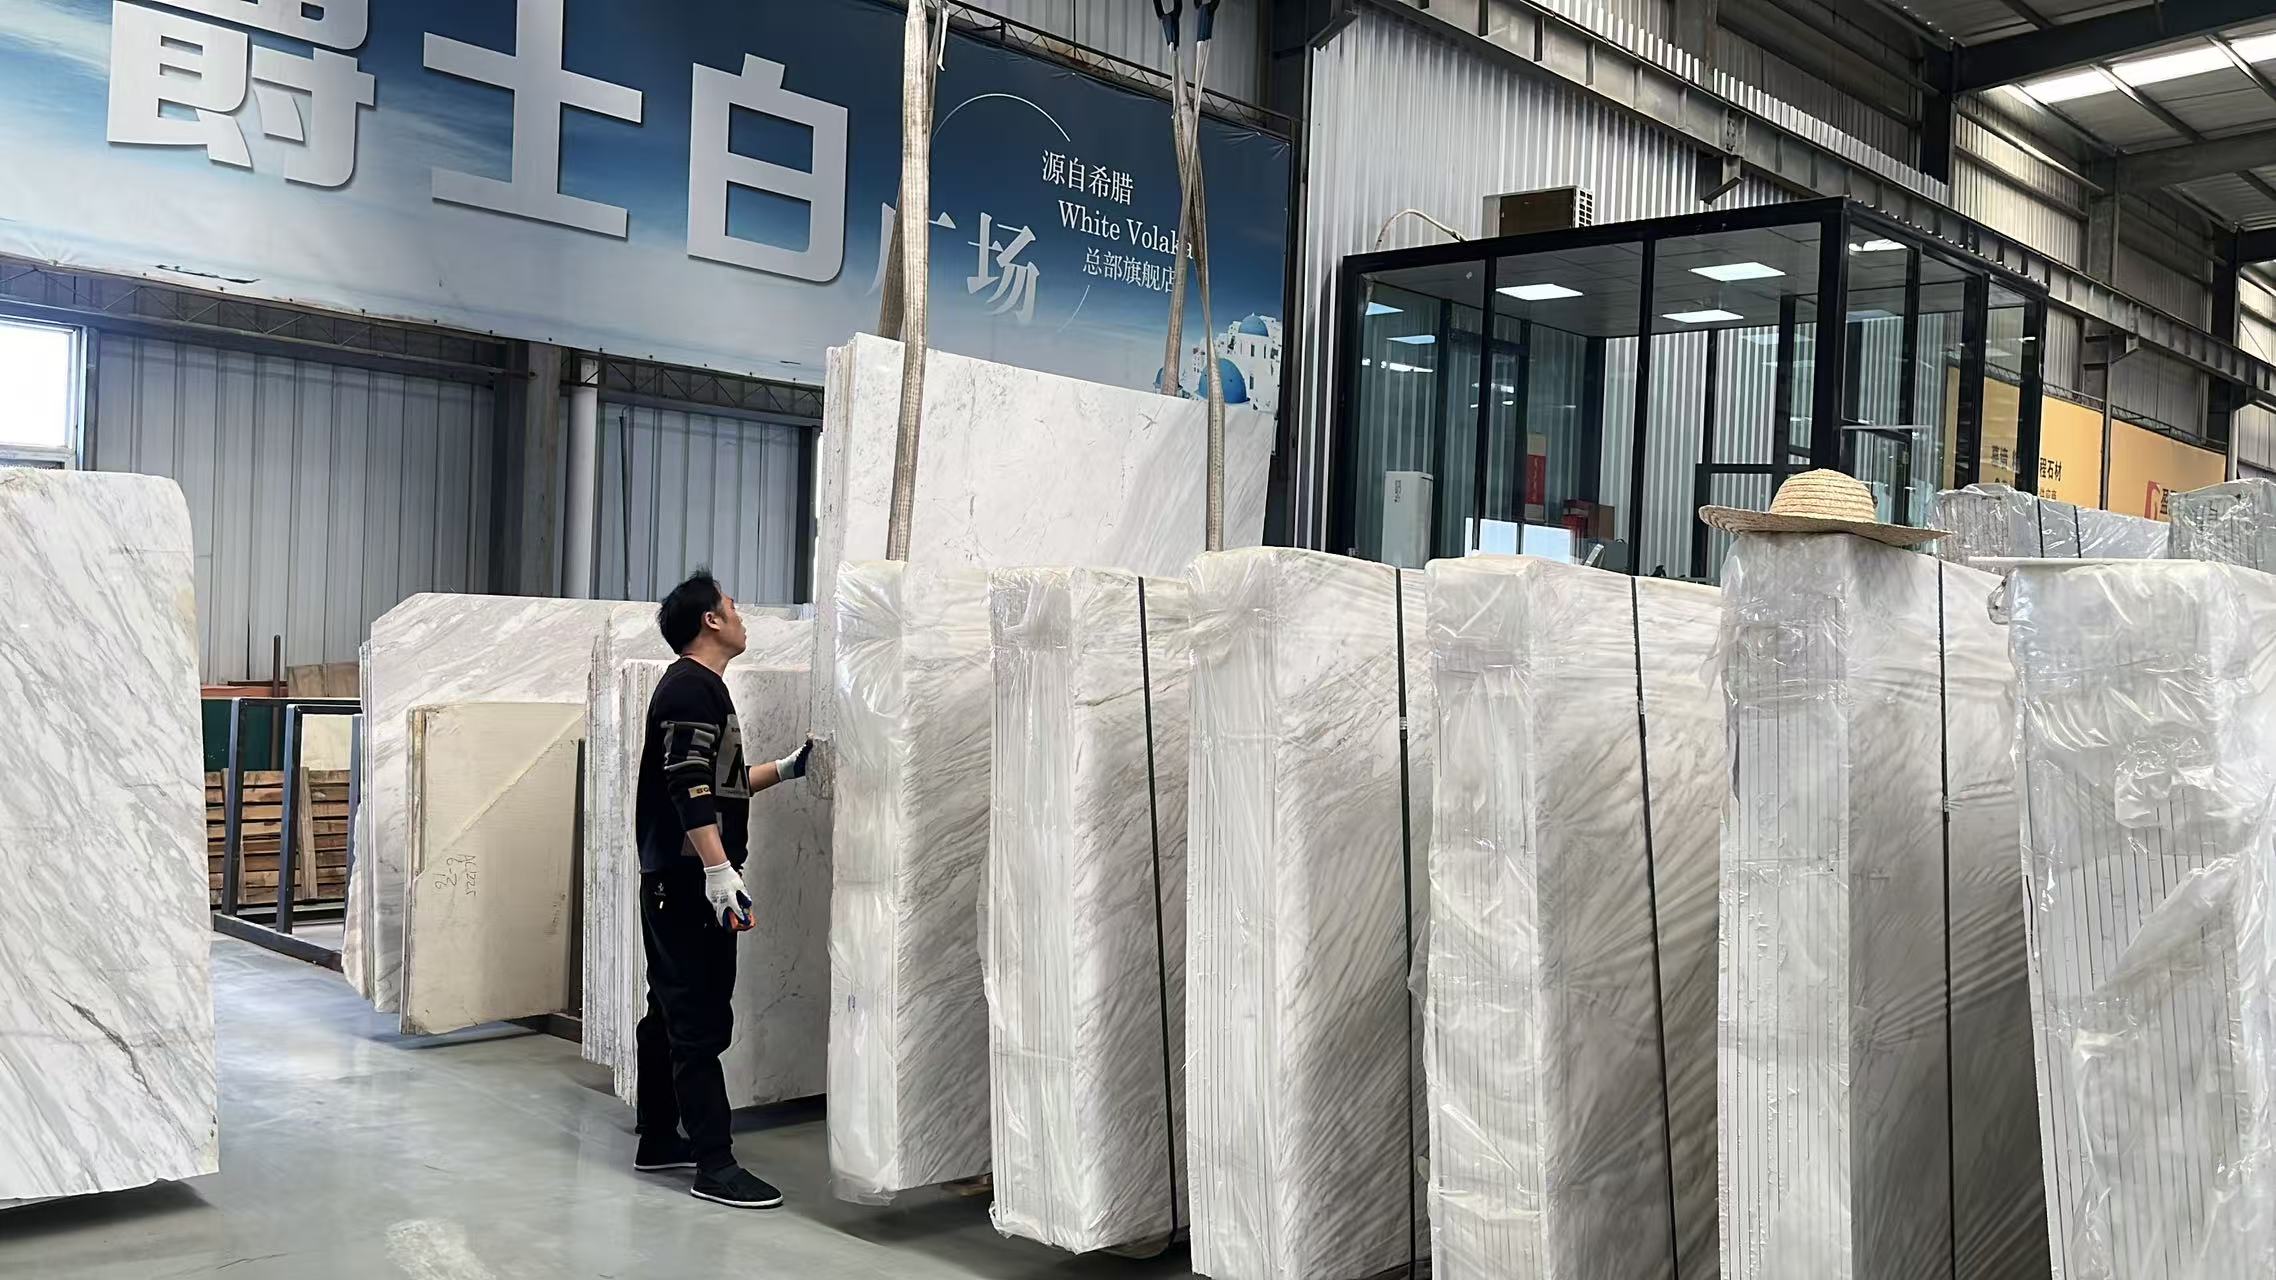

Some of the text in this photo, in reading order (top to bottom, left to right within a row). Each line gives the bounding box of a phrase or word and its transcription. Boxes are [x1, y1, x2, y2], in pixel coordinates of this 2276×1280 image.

[1042, 150, 1134, 206] 源自希腊
[1058, 200, 1121, 241] White
